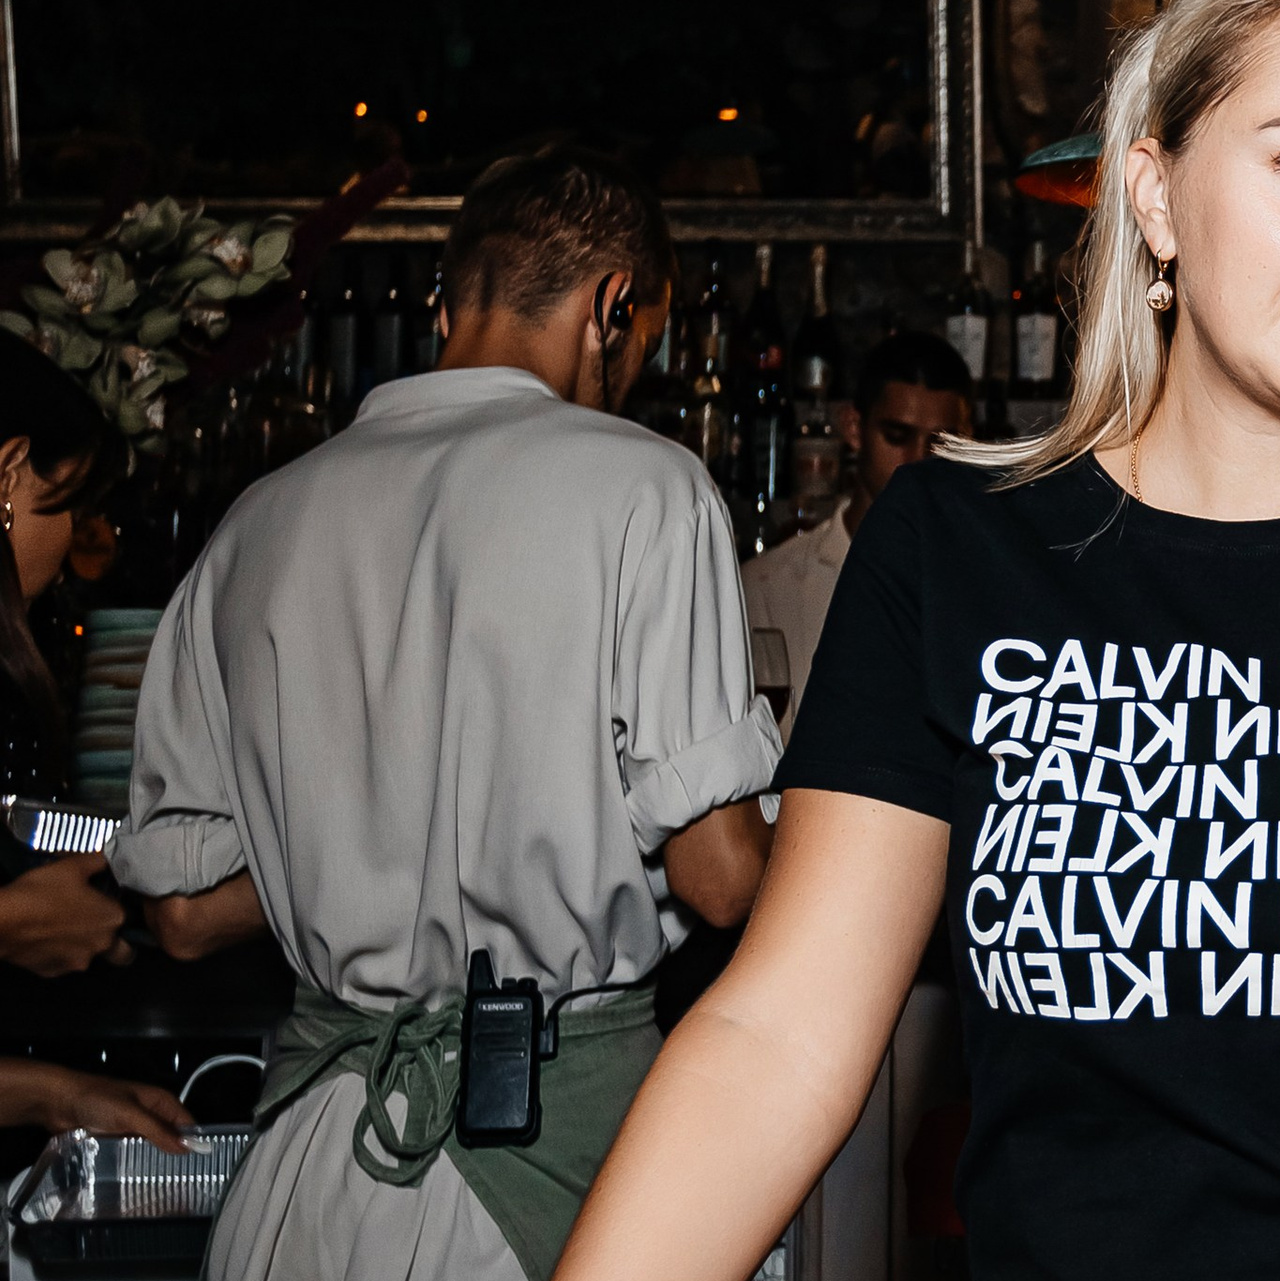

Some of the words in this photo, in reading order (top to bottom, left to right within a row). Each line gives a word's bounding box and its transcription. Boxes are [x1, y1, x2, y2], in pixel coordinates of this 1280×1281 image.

[982, 639, 1261, 704] CALVIN
[988, 740, 1259, 820] CALVIN
[965, 873, 1253, 949] CALVIN
[482, 1002, 524, 1011] KENWOOD
